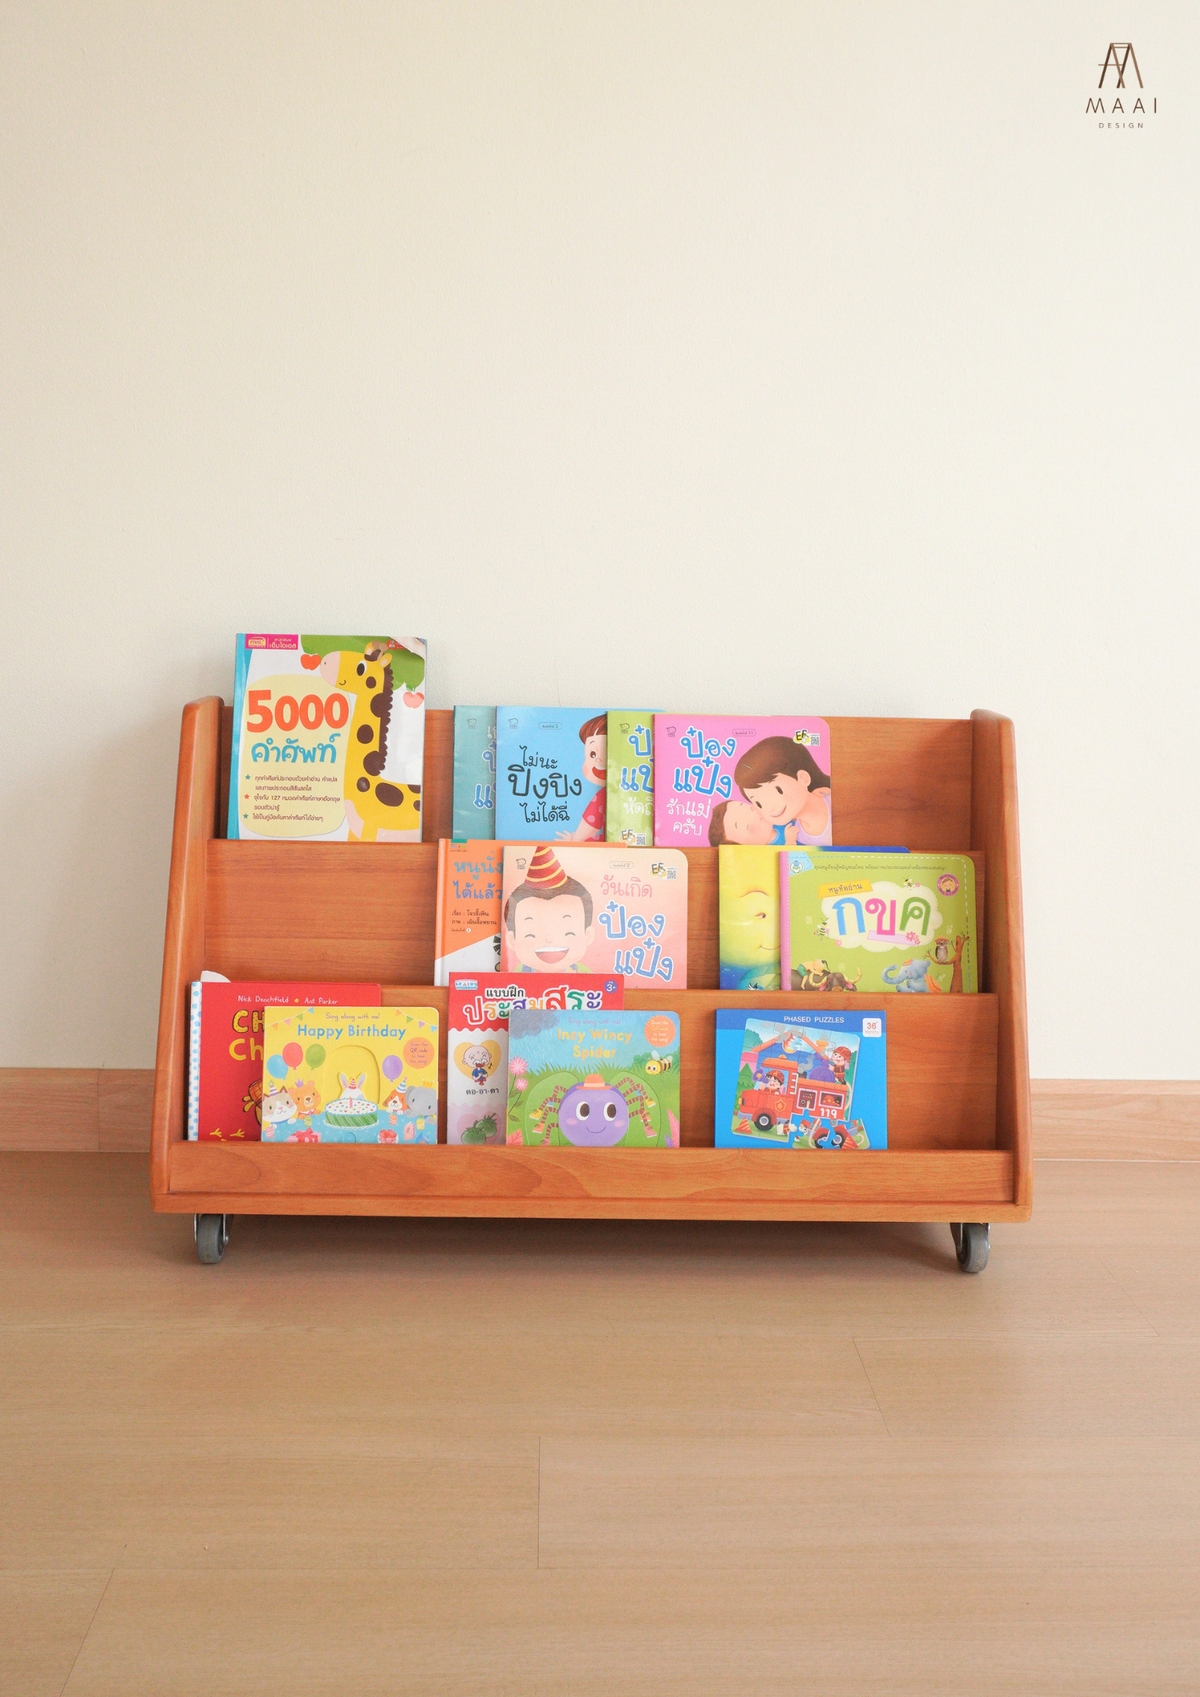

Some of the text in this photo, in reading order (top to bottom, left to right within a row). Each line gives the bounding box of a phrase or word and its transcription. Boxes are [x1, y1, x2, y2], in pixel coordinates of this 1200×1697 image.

[246, 689, 349, 733] 5000
[251, 733, 341, 764] คำศัพท์
[679, 726, 737, 759] ป๋อง
[519, 745, 558, 770] ไม่นะ
[507, 764, 582, 799] ปิงปิง
[673, 755, 733, 799] แป๋ง
[666, 798, 712, 819] รักแม่
[672, 818, 703, 836] ครับ
[600, 874, 653, 898] วันเกิด
[828, 883, 863, 895] หนูหัดอ่าน
[598, 900, 665, 939] ป๋อง
[614, 937, 674, 981] แป๋ง
[237, 995, 252, 1003] Nick
[255, 995, 289, 1003] Denchfield
[318, 997, 338, 1005] Parker
[486, 986, 525, 998] แบบฝึก
[325, 1012, 339, 1022] Sing
[341, 1012, 355, 1022] along
[568, 1016, 581, 1026] Sing
[583, 1017, 597, 1027] along
[814, 1016, 845, 1024] PUZZLES
[297, 1024, 406, 1040] Happy Birthday
[557, 1028, 632, 1045] Incy Wincy
[573, 1045, 617, 1060] Spider
[820, 1107, 837, 1119] 119
